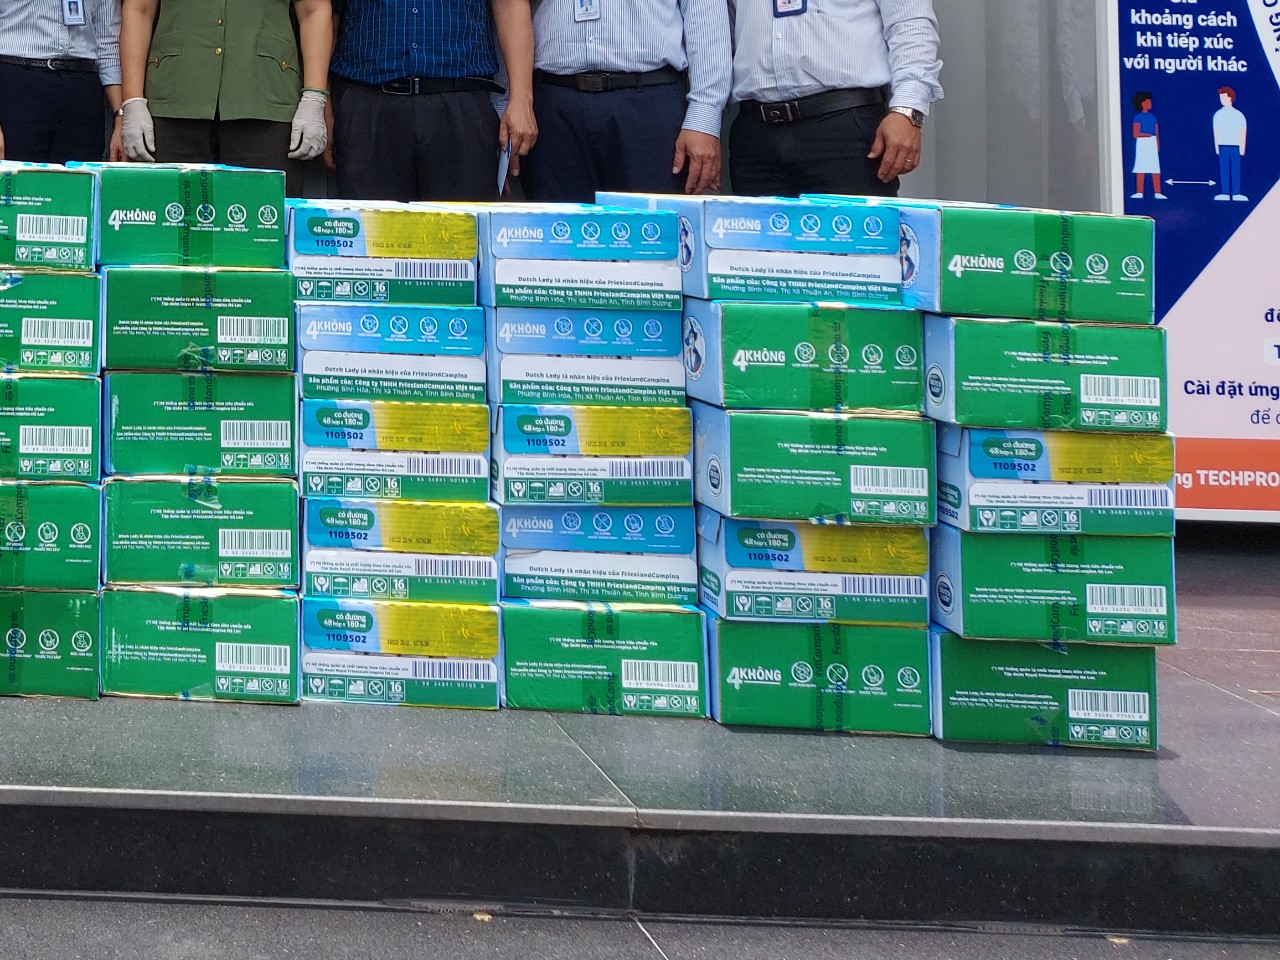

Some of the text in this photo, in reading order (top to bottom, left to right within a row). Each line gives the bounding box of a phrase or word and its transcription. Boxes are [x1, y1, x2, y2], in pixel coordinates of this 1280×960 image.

[1130, 8, 1238, 29] khoảng cách
[1136, 30, 1234, 52] khi tiếp xúc
[1123, 53, 1248, 74] với người khác
[315, 239, 354, 248] 1109502
[374, 282, 385, 292] 16
[1184, 380, 1280, 401] Cài đặt ứng
[1250, 407, 1271, 425] để
[544, 418, 565, 427] đường
[523, 424, 532, 432] 48
[546, 425, 558, 433] 180
[325, 431, 364, 440] 1109502
[526, 438, 566, 447] 1109502
[992, 461, 1036, 472] 1109502
[385, 478, 398, 489] 16
[588, 482, 601, 493] 16
[1063, 511, 1077, 523] 16
[328, 530, 368, 540] 1109502
[766, 531, 789, 541] đường
[744, 538, 754, 546] 48
[768, 539, 781, 547] 180
[747, 552, 790, 562] 1109502
[393, 578, 405, 589] 16
[819, 597, 832, 609] 16
[326, 633, 367, 644] 1109502
[389, 681, 402, 692] 16
